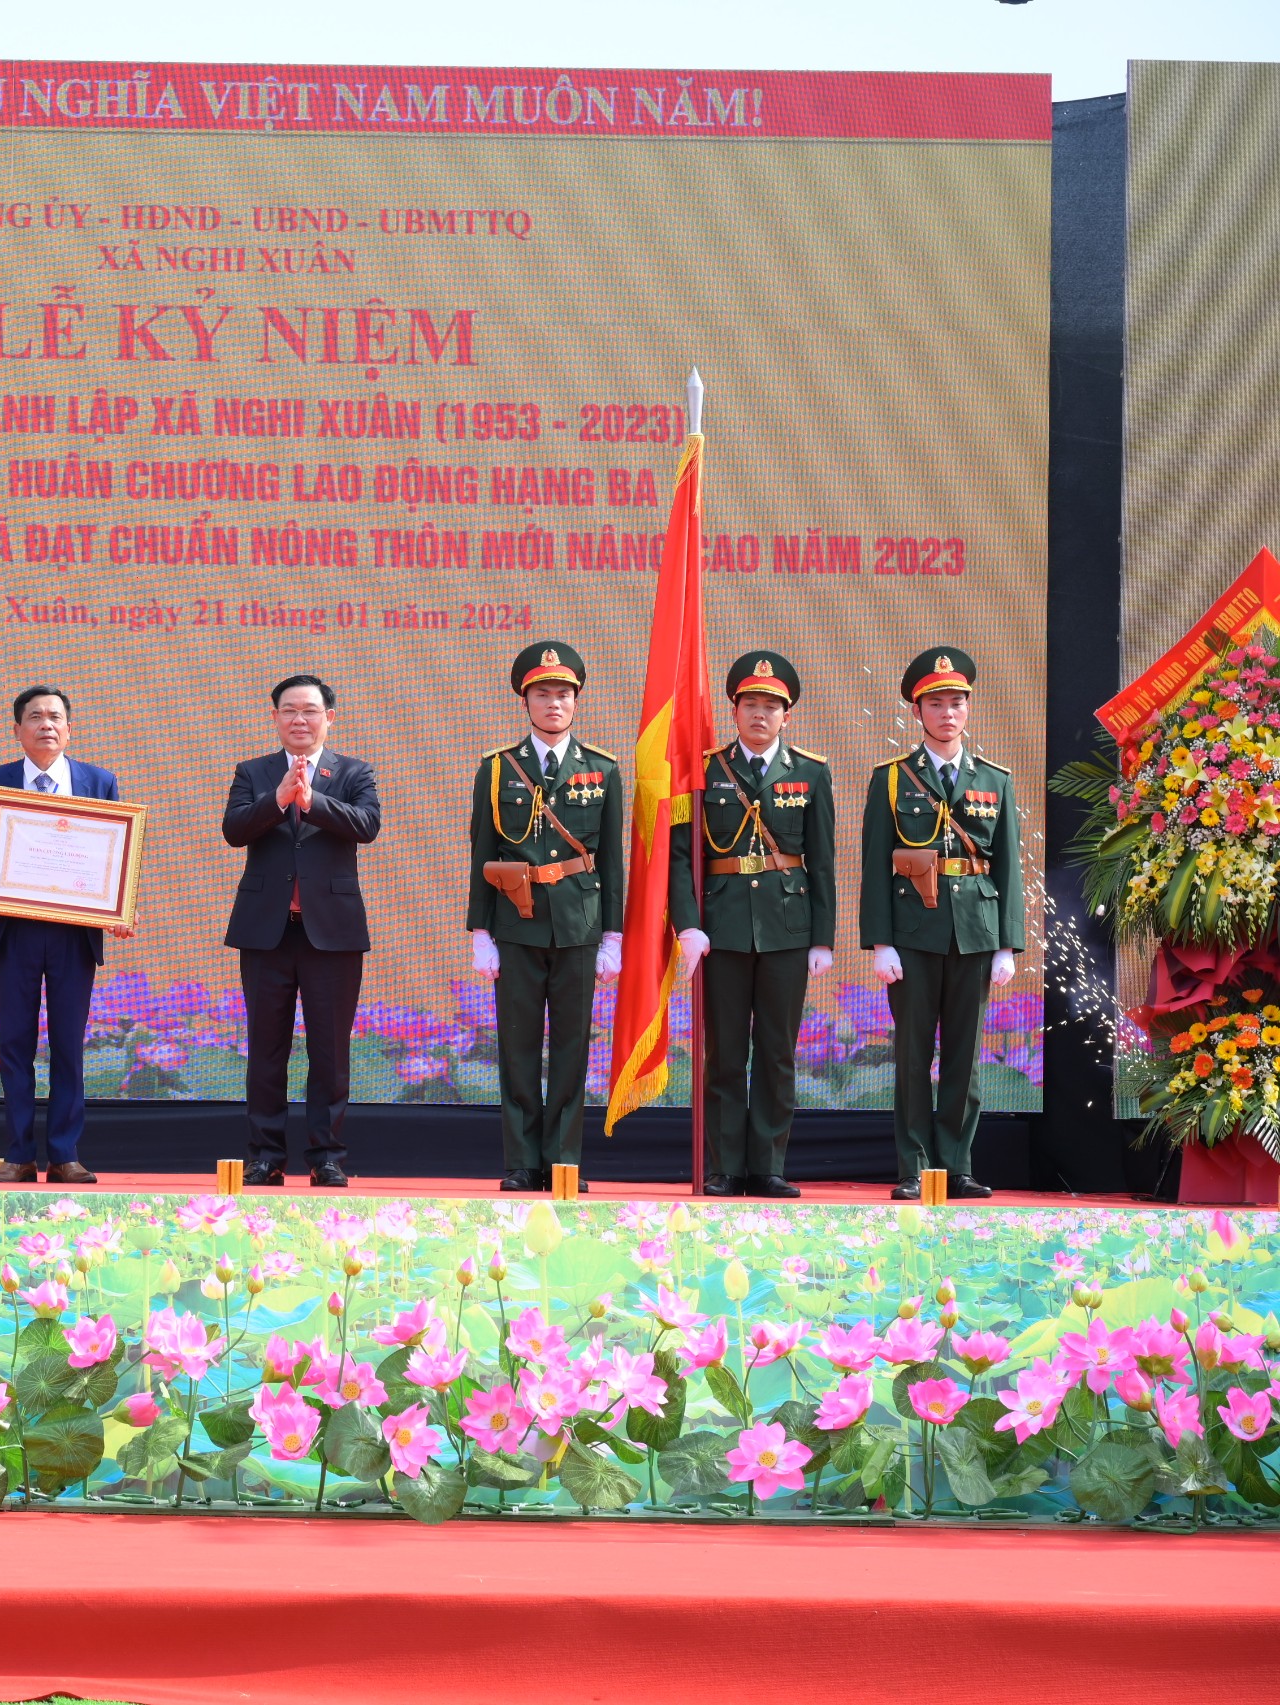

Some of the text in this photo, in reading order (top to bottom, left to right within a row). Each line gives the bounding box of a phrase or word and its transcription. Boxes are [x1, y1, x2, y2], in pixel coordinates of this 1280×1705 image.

[21, 70, 186, 119] NGHĨA
[199, 75, 319, 131] VIỆT
[332, 82, 450, 123] NAM
[461, 73, 618, 126] MUÔN
[630, 76, 763, 128] NĂM!
[43, 194, 92, 230] ỦY
[121, 204, 222, 232] HĐND
[252, 206, 349, 234] UBND
[379, 207, 534, 241] UBMTTQ
[97, 240, 357, 275] XÃ NGHI XUÂN
[113, 287, 234, 362] KỶ
[256, 297, 480, 382] NIỆM
[67, 387, 139, 444] LẬP
[151, 389, 202, 436] XÃ
[214, 397, 304, 437] NGHI
[317, 392, 420, 440] XUÂN
[435, 402, 541, 444] (1953
[578, 403, 685, 447] 2023)
[9, 451, 113, 499] HUÂN
[126, 457, 280, 502] CHƯƠNG
[292, 462, 362, 503] LAO
[374, 456, 479, 512] ĐỘNG
[491, 465, 595, 514] HẠNG
[608, 467, 658, 508] BA
[25, 524, 97, 572] ĐẠT
[109, 510, 238, 566] CHUẨN
[250, 519, 357, 568] NÔNG
[369, 521, 469, 569] THÔN
[482, 523, 555, 571] MỚI
[773, 527, 862, 575] NĂM
[874, 536, 965, 577] 2023
[5, 595, 99, 627] Xuân,
[109, 598, 183, 633] ngày
[193, 599, 227, 627] 21
[239, 600, 326, 634] tháng
[335, 601, 368, 629] 01
[382, 603, 449, 630] năm
[460, 602, 532, 631] 2024
[1107, 706, 1142, 732] TỈNH
[1151, 660, 1188, 697] HĐND
[1213, 587, 1262, 634] UBMTTQ
